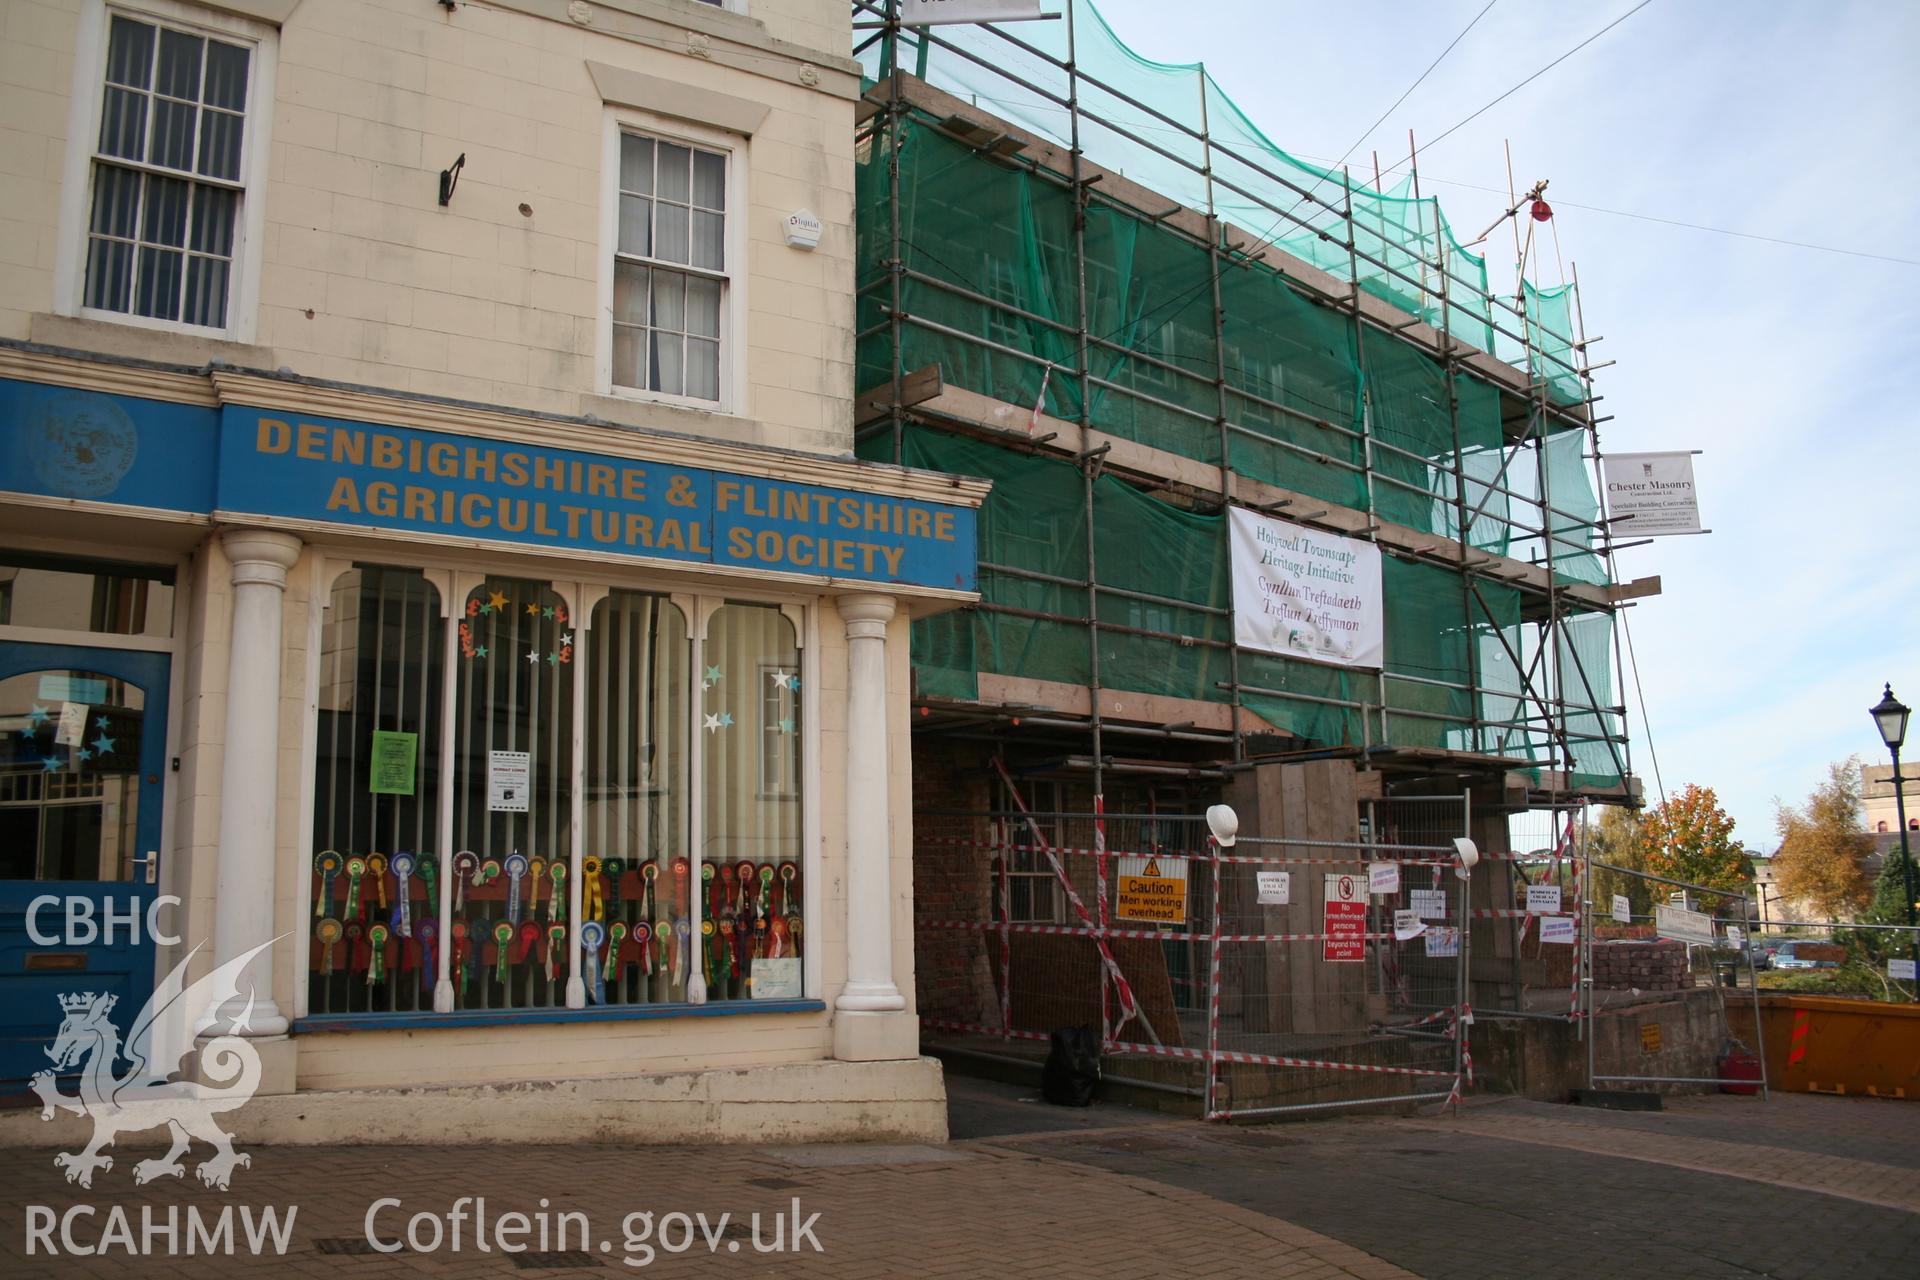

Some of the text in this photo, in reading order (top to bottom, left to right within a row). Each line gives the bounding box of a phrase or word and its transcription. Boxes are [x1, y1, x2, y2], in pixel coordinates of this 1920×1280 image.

[256, 417, 956, 541] DENBIGHSHIRE & FLINTSHIRE
[1608, 480, 1692, 493] Chester Masonry
[326, 477, 905, 577] AGRICULTURAL SOCIETY
[1256, 526, 1356, 568] Holywell Townscape
[1260, 549, 1354, 584] Heritage Initiative
[1258, 576, 1361, 611] Cynllun Treftadaeth
[1304, 608, 1360, 632] Treffynnon
[1129, 880, 1174, 895] Caution
[1120, 895, 1182, 910] Men working
[1128, 909, 1174, 919] overhead
[1333, 923, 1356, 931] persons
[1327, 941, 1349, 949] beyond
